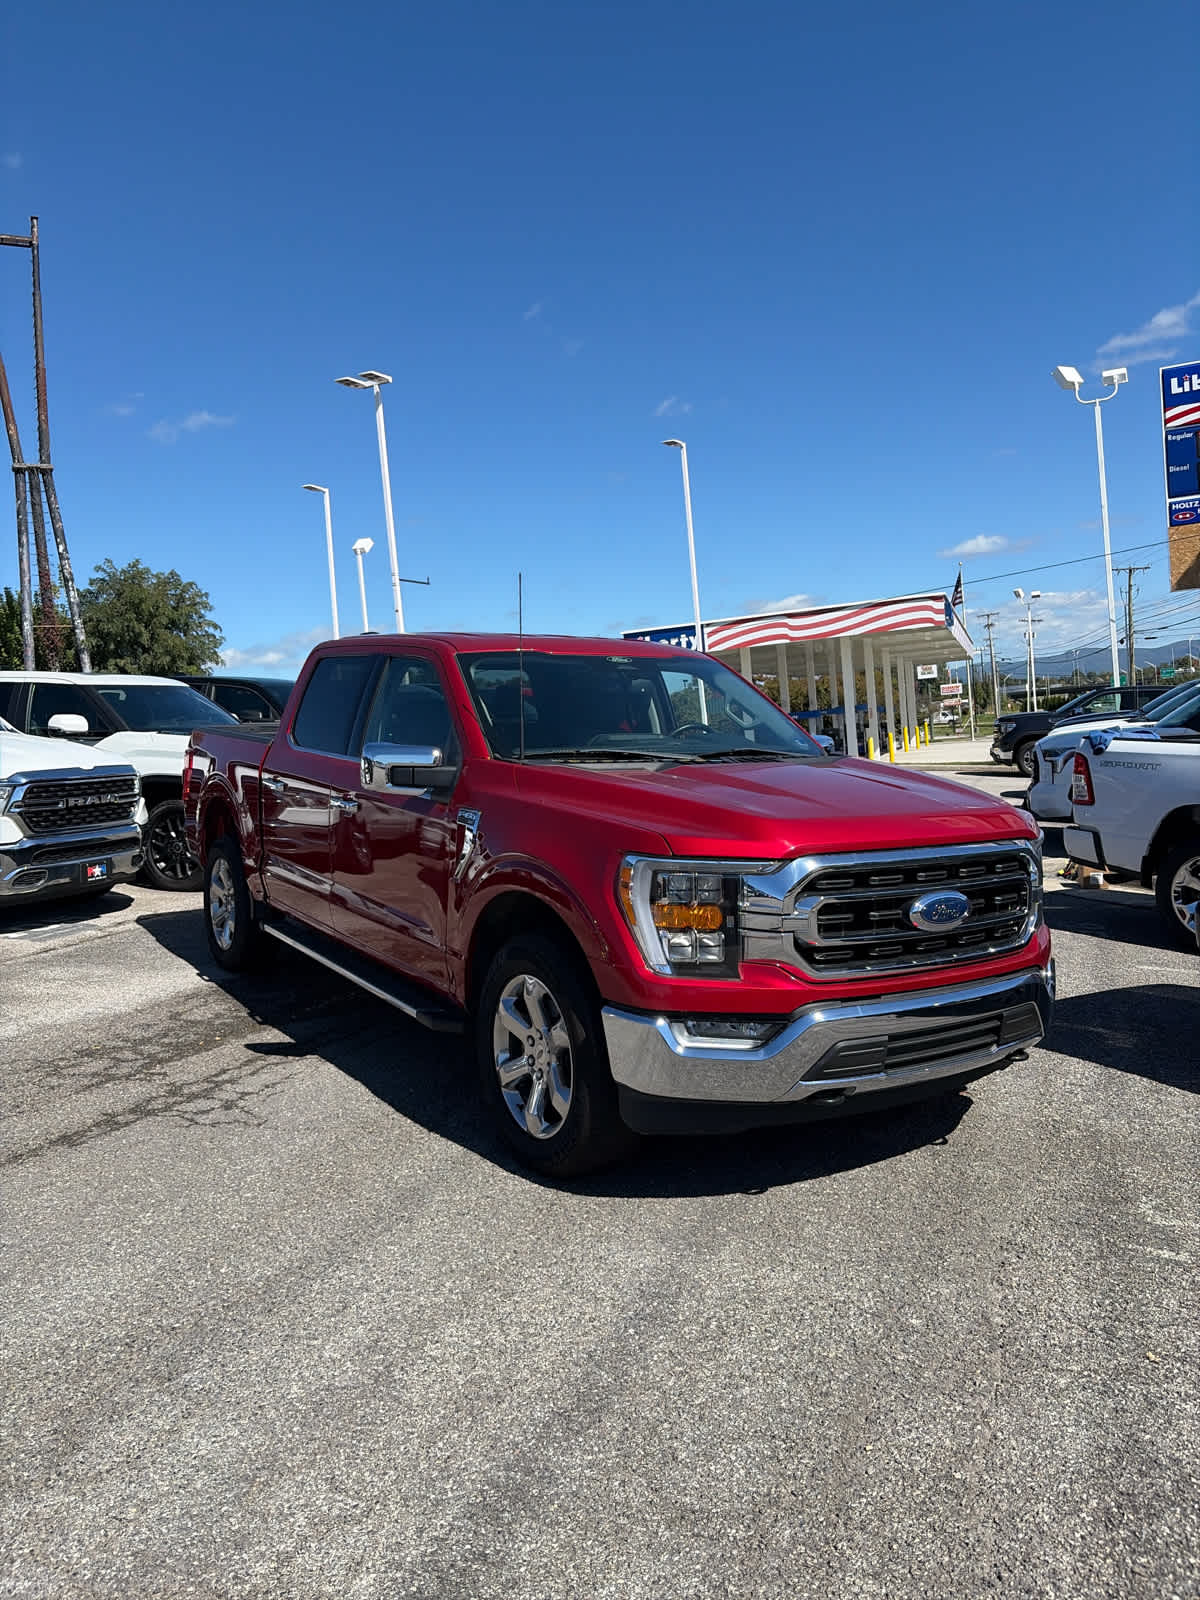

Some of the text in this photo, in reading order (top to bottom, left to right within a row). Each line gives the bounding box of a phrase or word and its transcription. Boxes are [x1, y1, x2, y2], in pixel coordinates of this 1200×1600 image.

[1168, 432, 1193, 441] Regular
[1169, 463, 1190, 472] Diesel
[1100, 760, 1161, 770] SPORT
